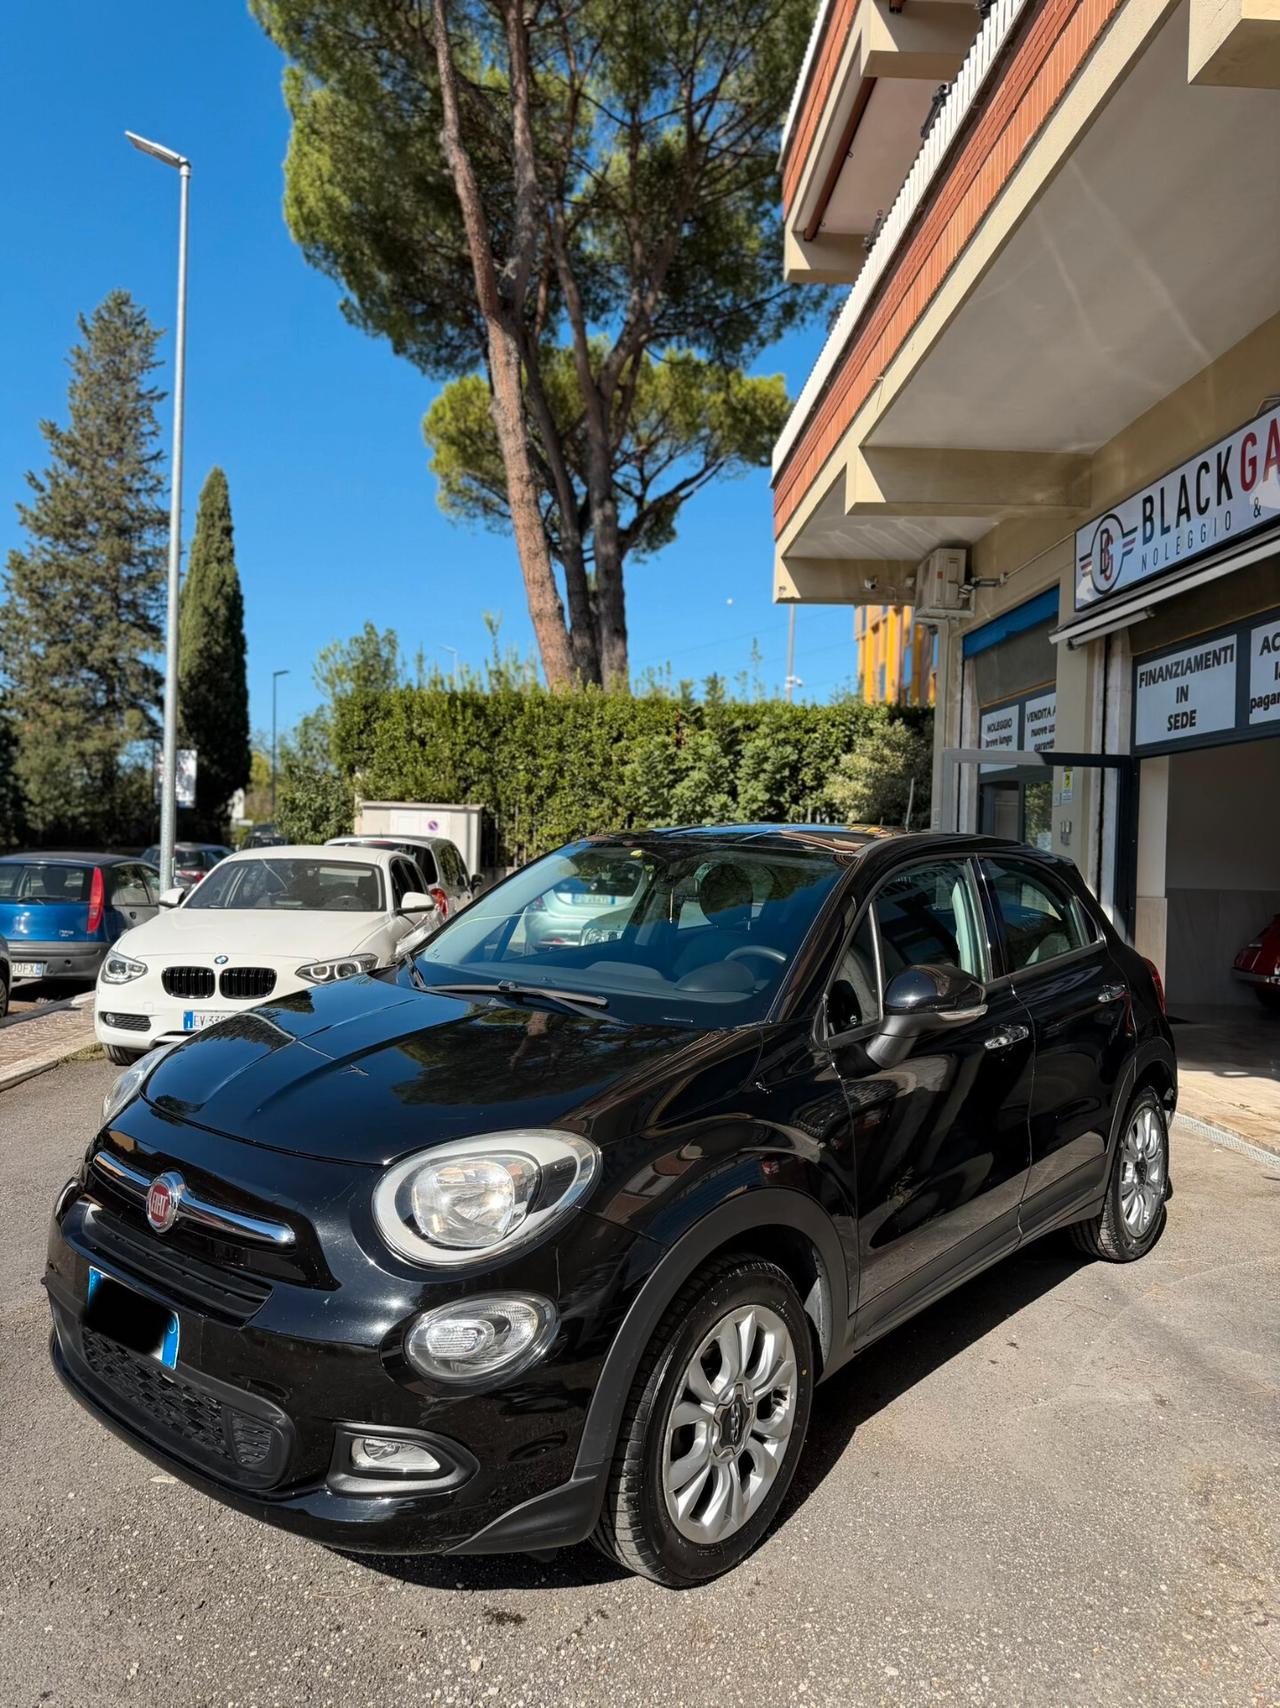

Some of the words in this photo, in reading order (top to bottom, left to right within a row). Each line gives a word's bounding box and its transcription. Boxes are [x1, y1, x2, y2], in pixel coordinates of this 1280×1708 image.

[1141, 510, 1231, 573] NOLEGGIO
[1253, 496, 1262, 519] &
[1138, 643, 1235, 689] FINANZIAMENTI
[1175, 684, 1189, 704] IN
[987, 717, 1013, 734] NOLEGGIO
[1026, 706, 1052, 723] VENDITA
[1167, 709, 1197, 732] SEDE
[151, 1190, 169, 1217] FIAT
